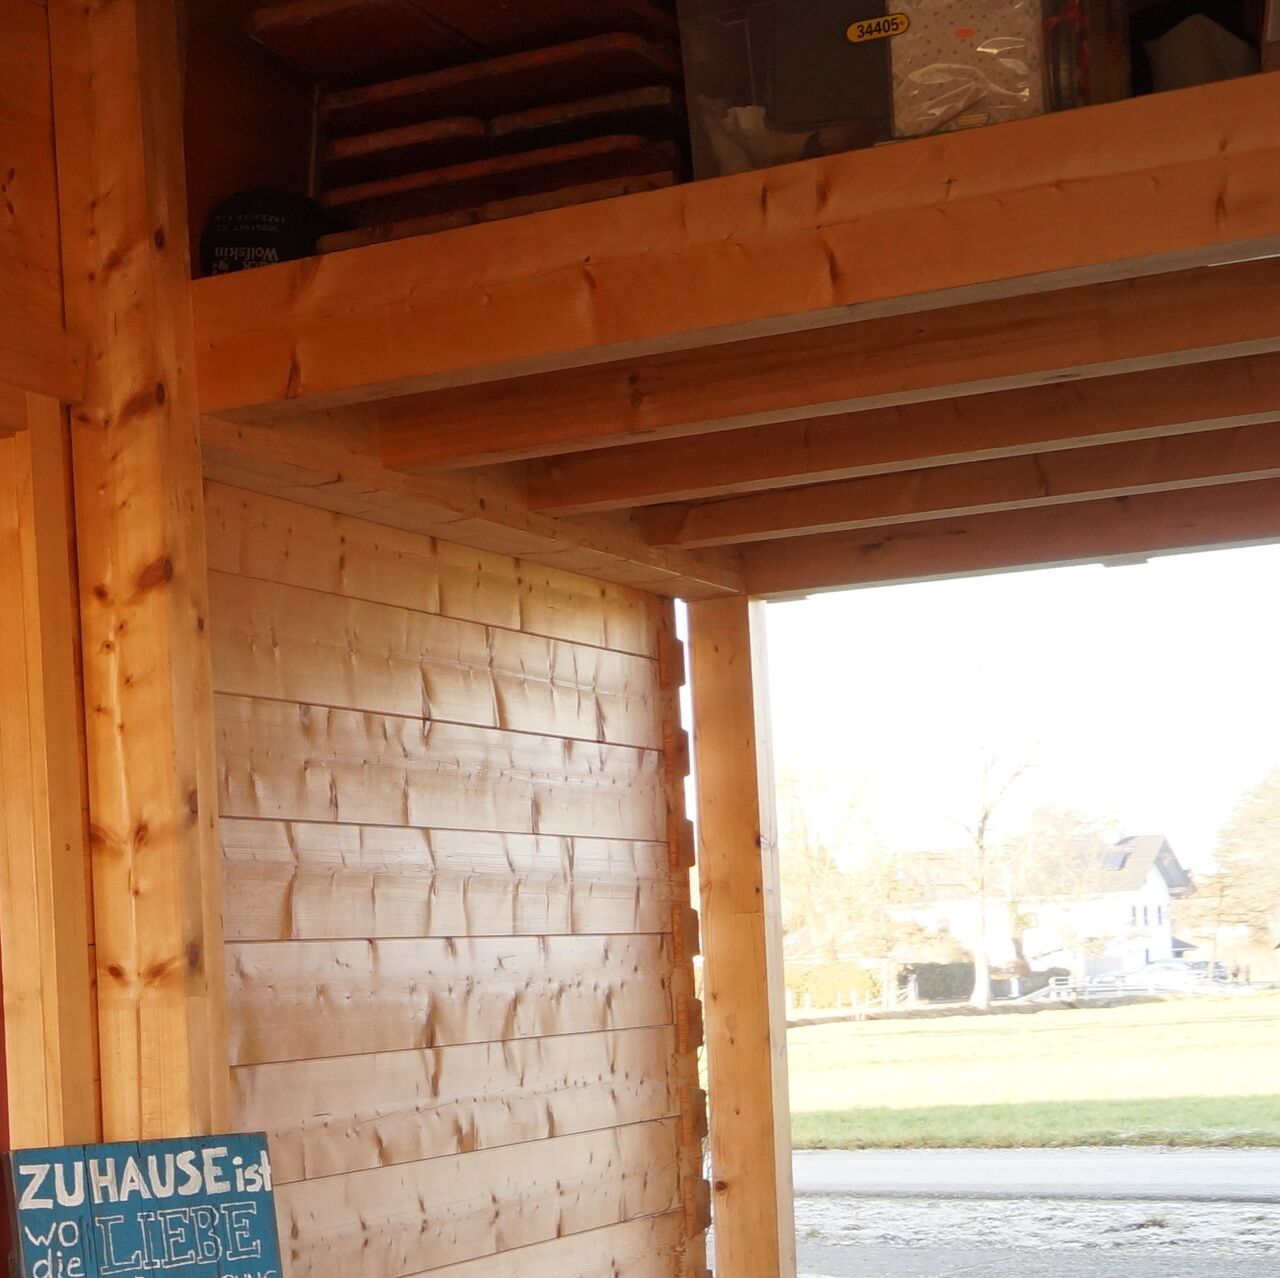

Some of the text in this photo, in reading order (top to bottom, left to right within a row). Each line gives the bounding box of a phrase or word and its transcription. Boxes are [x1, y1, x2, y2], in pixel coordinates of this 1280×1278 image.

[856, 17, 899, 38] 34405
[18, 1147, 272, 1210] ZUHAUSE ist
[95, 1201, 262, 1275] LIEBE
